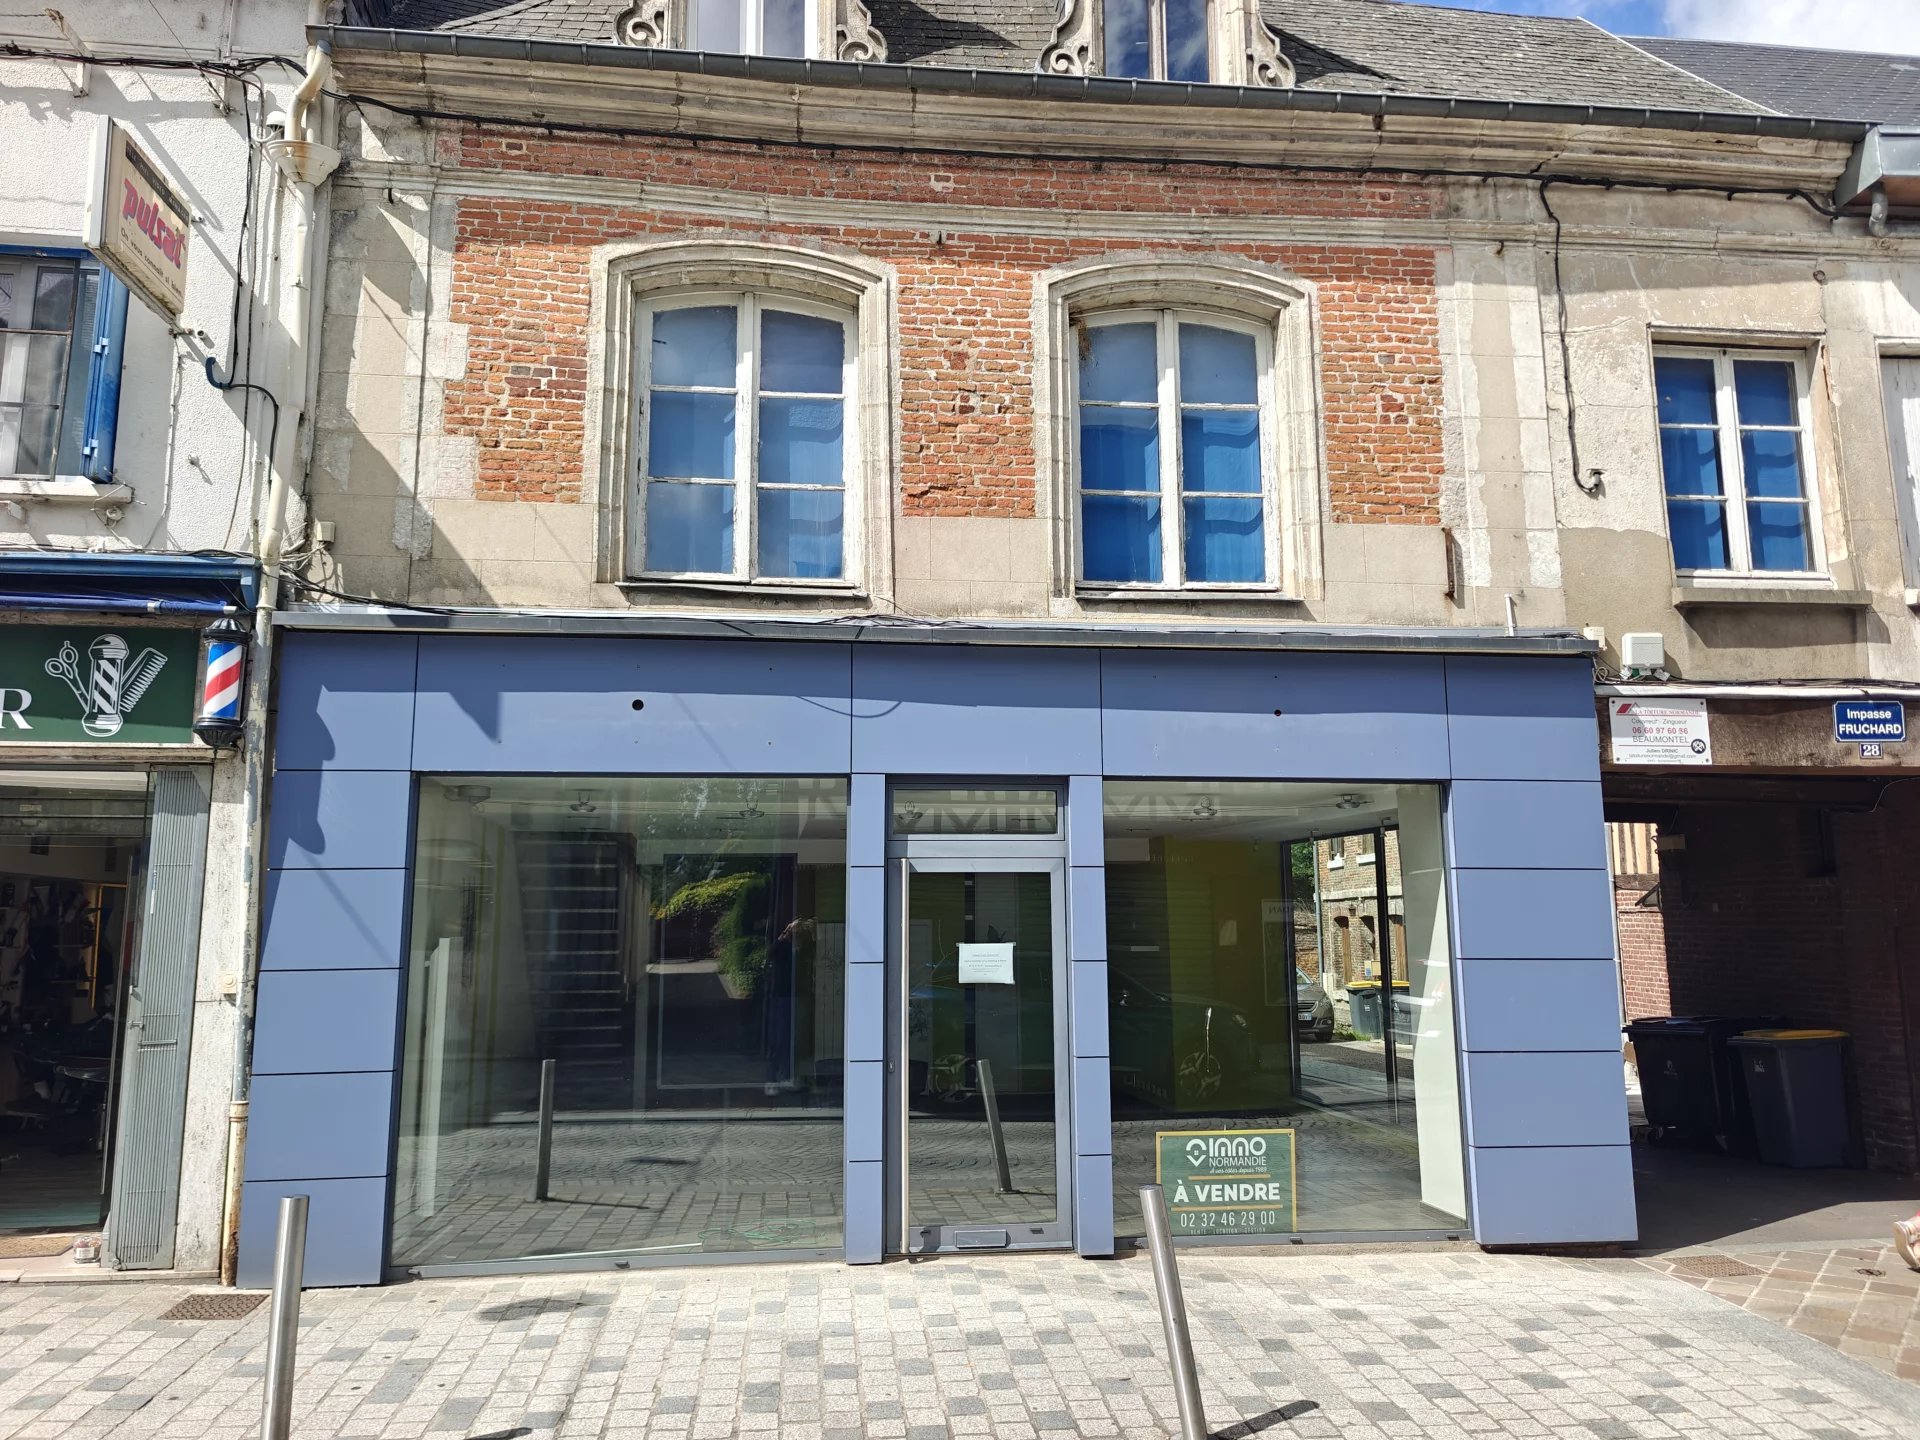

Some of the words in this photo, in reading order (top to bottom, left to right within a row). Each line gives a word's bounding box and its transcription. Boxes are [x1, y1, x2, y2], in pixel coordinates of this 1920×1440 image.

[123, 178, 186, 270] pulsat
[130, 240, 143, 257] vous
[1847, 708, 1892, 721] Impasse
[1632, 726, 1642, 734] 06
[1838, 723, 1902, 735] FRUCHARD
[1632, 735, 1690, 744] BEAUMONTEL
[1862, 744, 1880, 756] 28
[1208, 1156, 1267, 1167] NORMANDIE
[1173, 1179, 1190, 1203] À
[1194, 1182, 1281, 1203] VENDRE
[1180, 1213, 1196, 1228] 02
[1201, 1212, 1216, 1227] 32
[1220, 1211, 1235, 1226] 46
[1241, 1211, 1255, 1226] 29
[1260, 1210, 1275, 1225] 00
